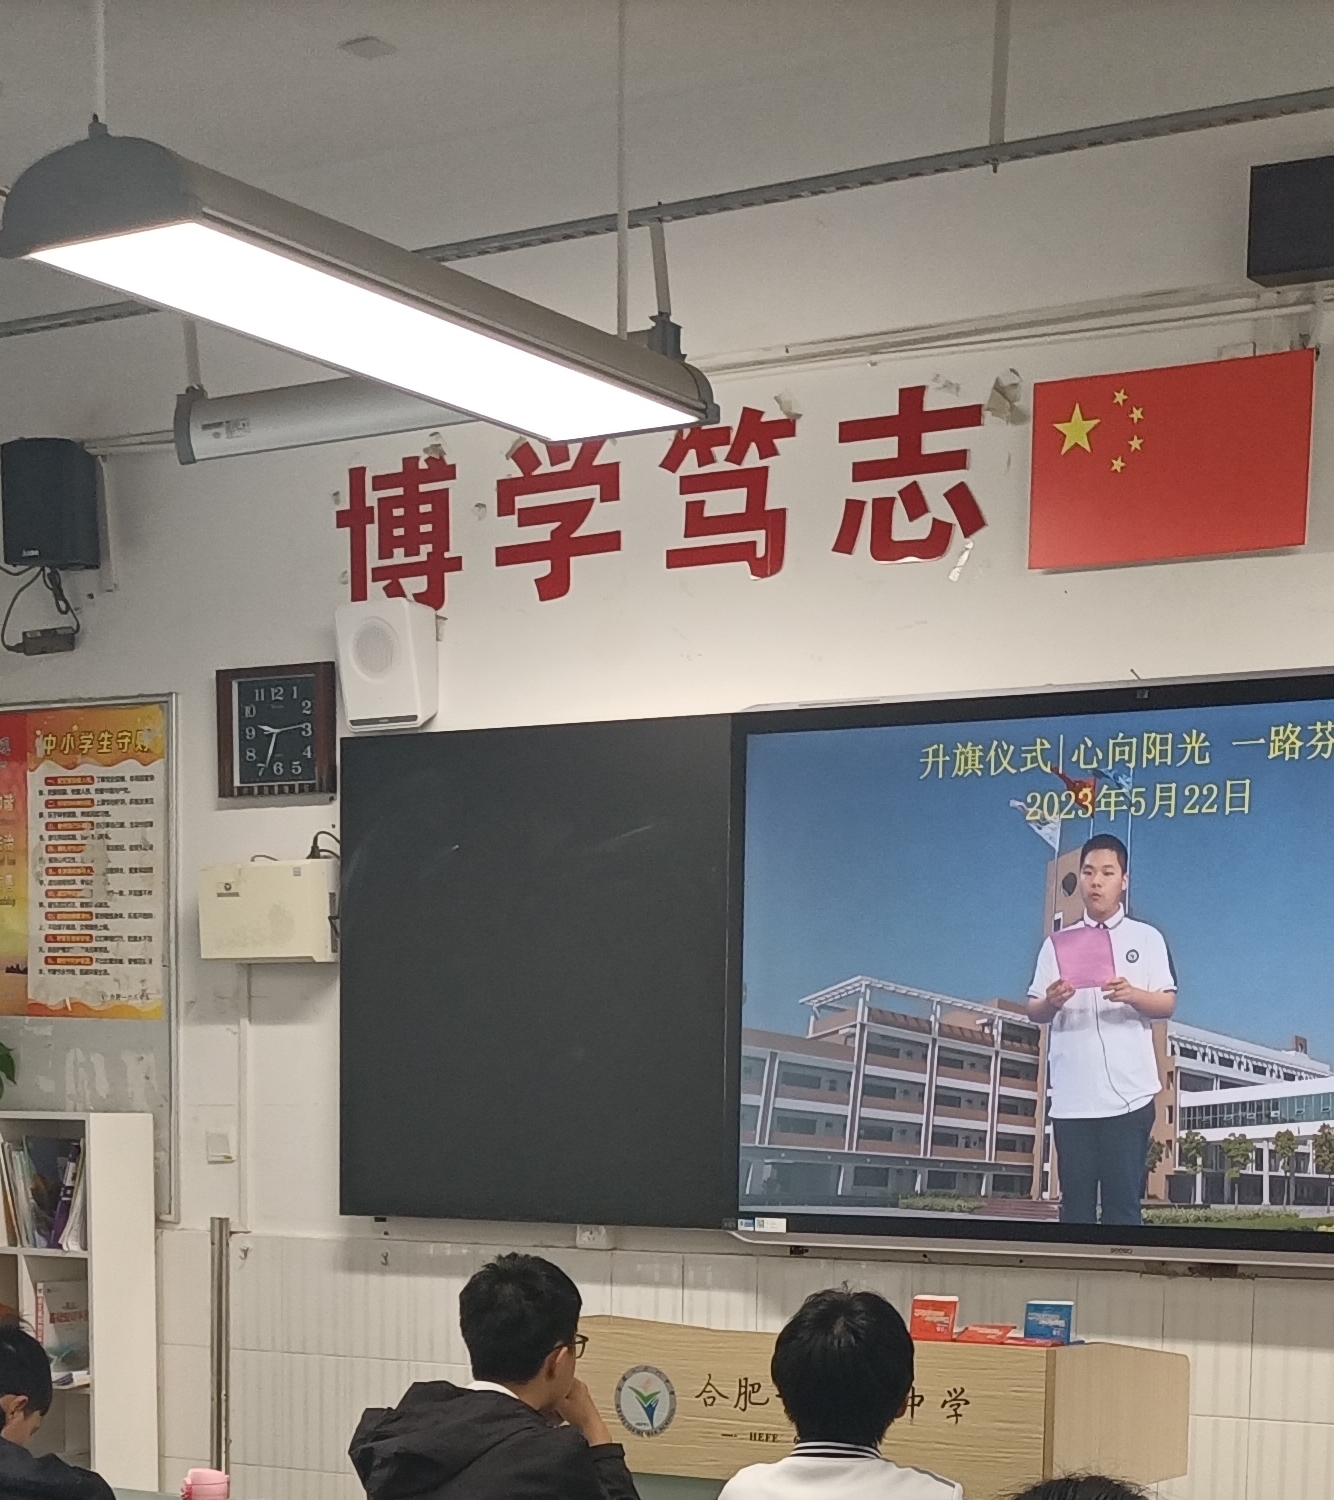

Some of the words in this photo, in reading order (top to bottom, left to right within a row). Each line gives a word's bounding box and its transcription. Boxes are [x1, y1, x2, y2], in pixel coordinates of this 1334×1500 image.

[336, 385, 986, 612] 博学笃志
[254, 688, 265, 701] 11
[270, 686, 284, 700] 12
[292, 686, 298, 699] 1
[244, 703, 256, 718] 10
[301, 700, 312, 714] 2
[245, 726, 256, 740] 9
[245, 747, 257, 762] 8
[302, 745, 312, 759] 4
[273, 761, 284, 775] 6
[291, 760, 302, 775] 5
[1026, 778, 1252, 822] 2023年5月22日
